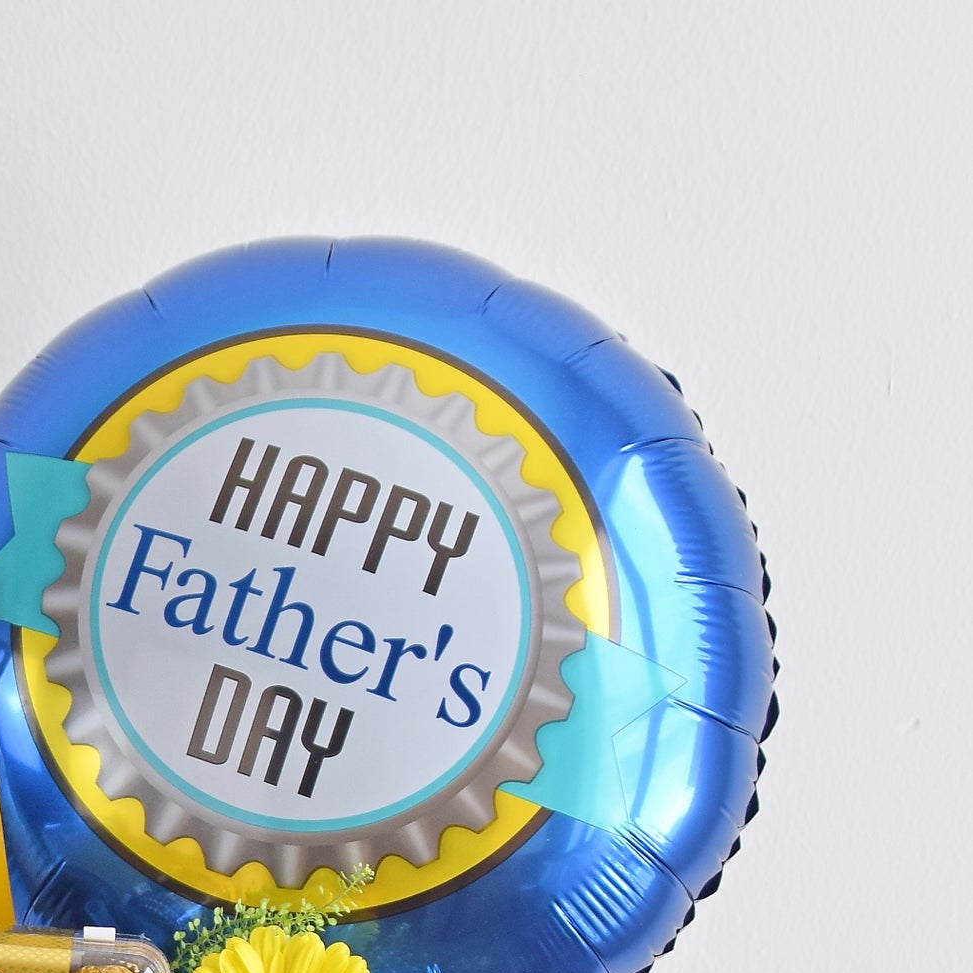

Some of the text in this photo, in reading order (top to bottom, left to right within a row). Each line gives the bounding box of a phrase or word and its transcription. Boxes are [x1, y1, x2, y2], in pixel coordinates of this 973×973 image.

[208, 436, 480, 597] HAPPY
[106, 523, 491, 728] Father's
[186, 663, 355, 799] DAY
